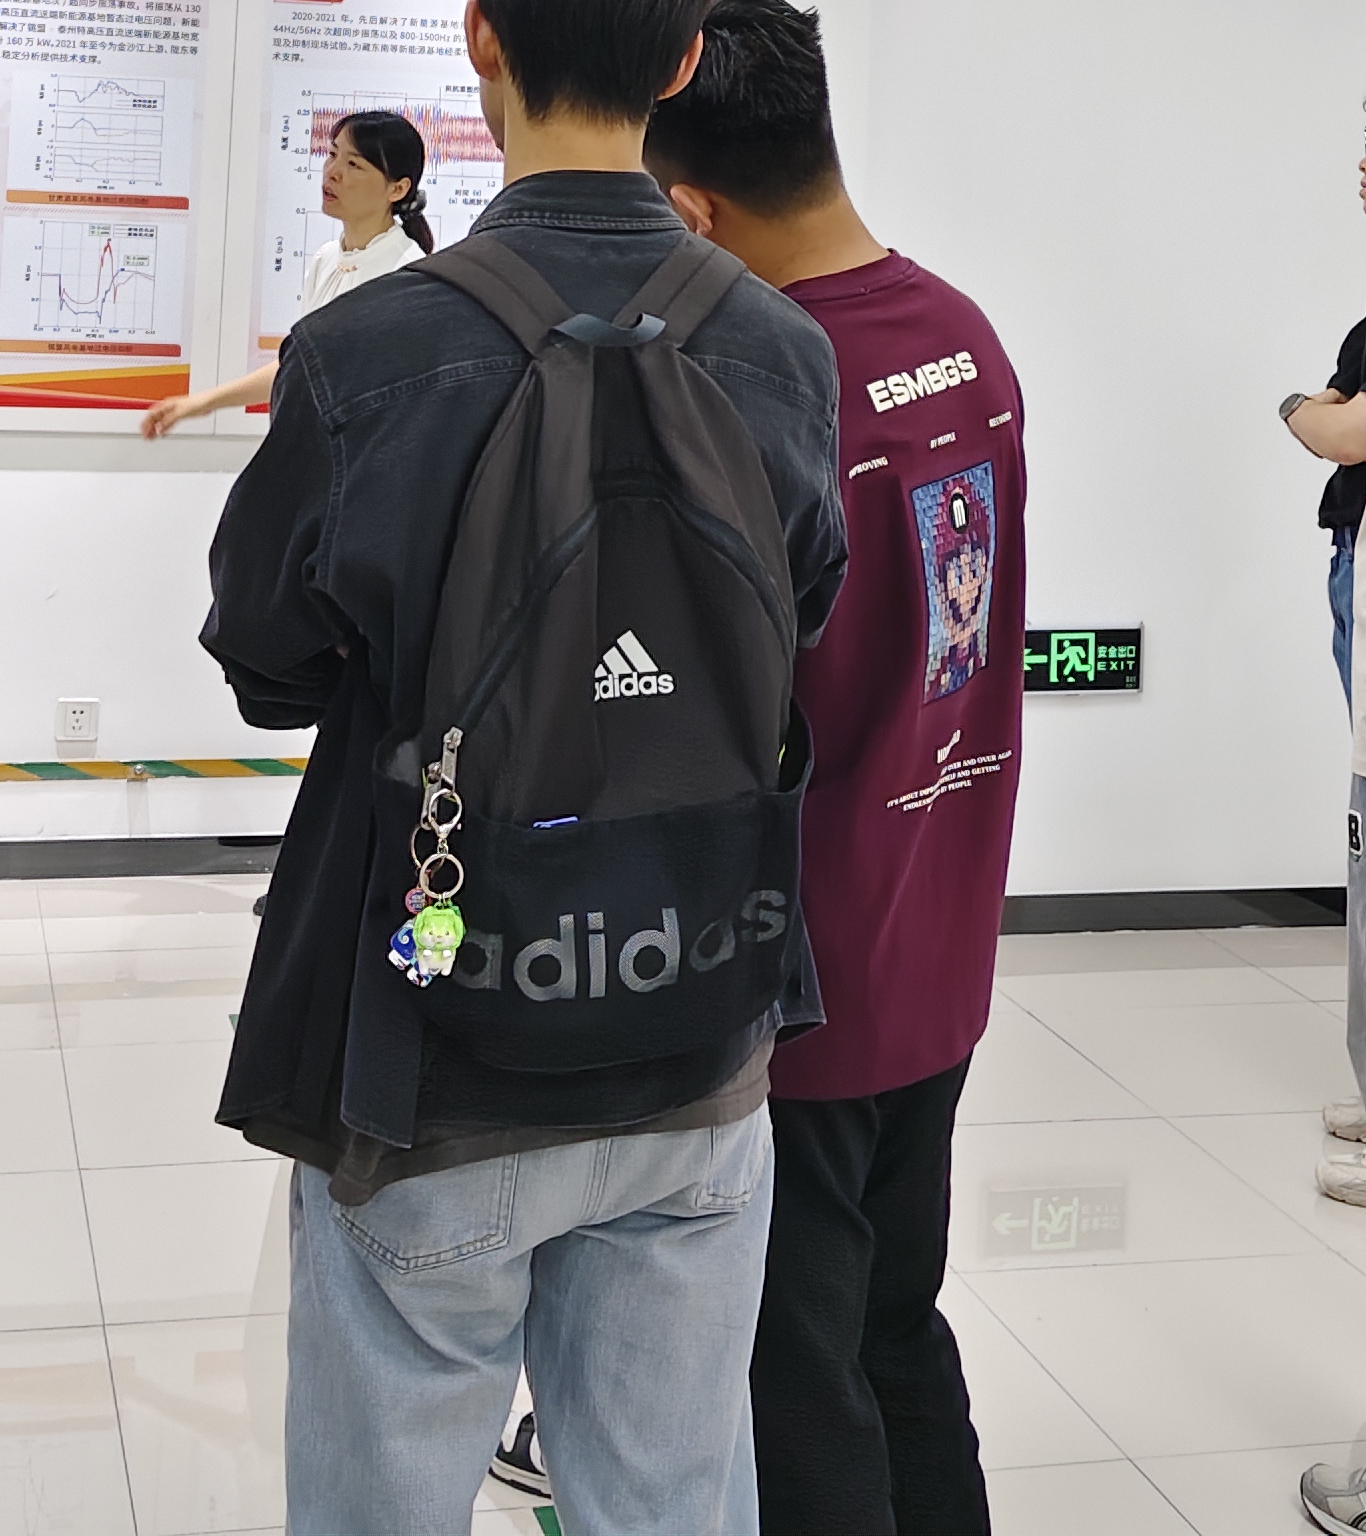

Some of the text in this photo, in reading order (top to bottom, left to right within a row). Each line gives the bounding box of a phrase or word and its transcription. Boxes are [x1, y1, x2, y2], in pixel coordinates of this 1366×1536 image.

[291, 11, 336, 22] 2020-2021
[866, 351, 978, 413] ESMBGS
[1097, 645, 1136, 658] 安全出口
[1097, 660, 1136, 671] EXIT
